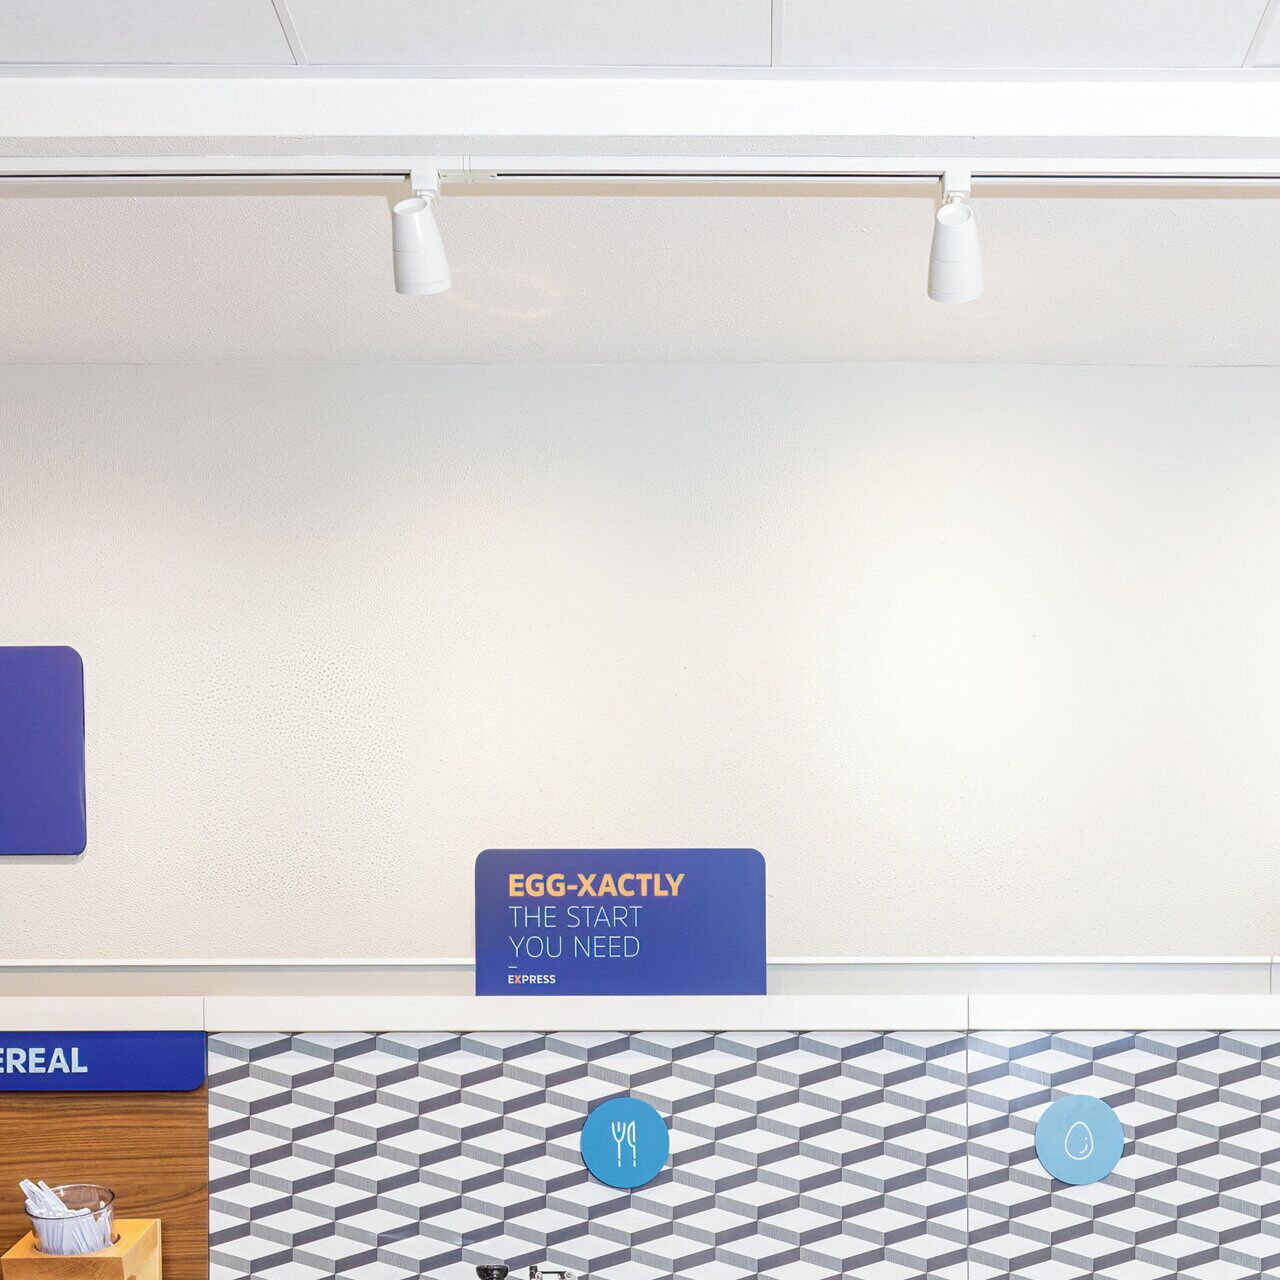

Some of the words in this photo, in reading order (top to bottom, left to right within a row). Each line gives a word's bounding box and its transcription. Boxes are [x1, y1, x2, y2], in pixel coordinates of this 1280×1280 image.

[508, 873, 685, 897] EGG-XACTLY
[508, 905, 557, 928] THE
[566, 905, 643, 928] START
[508, 935, 562, 958] YOU
[573, 935, 640, 958] NEED
[507, 974, 557, 985] EXPRESS
